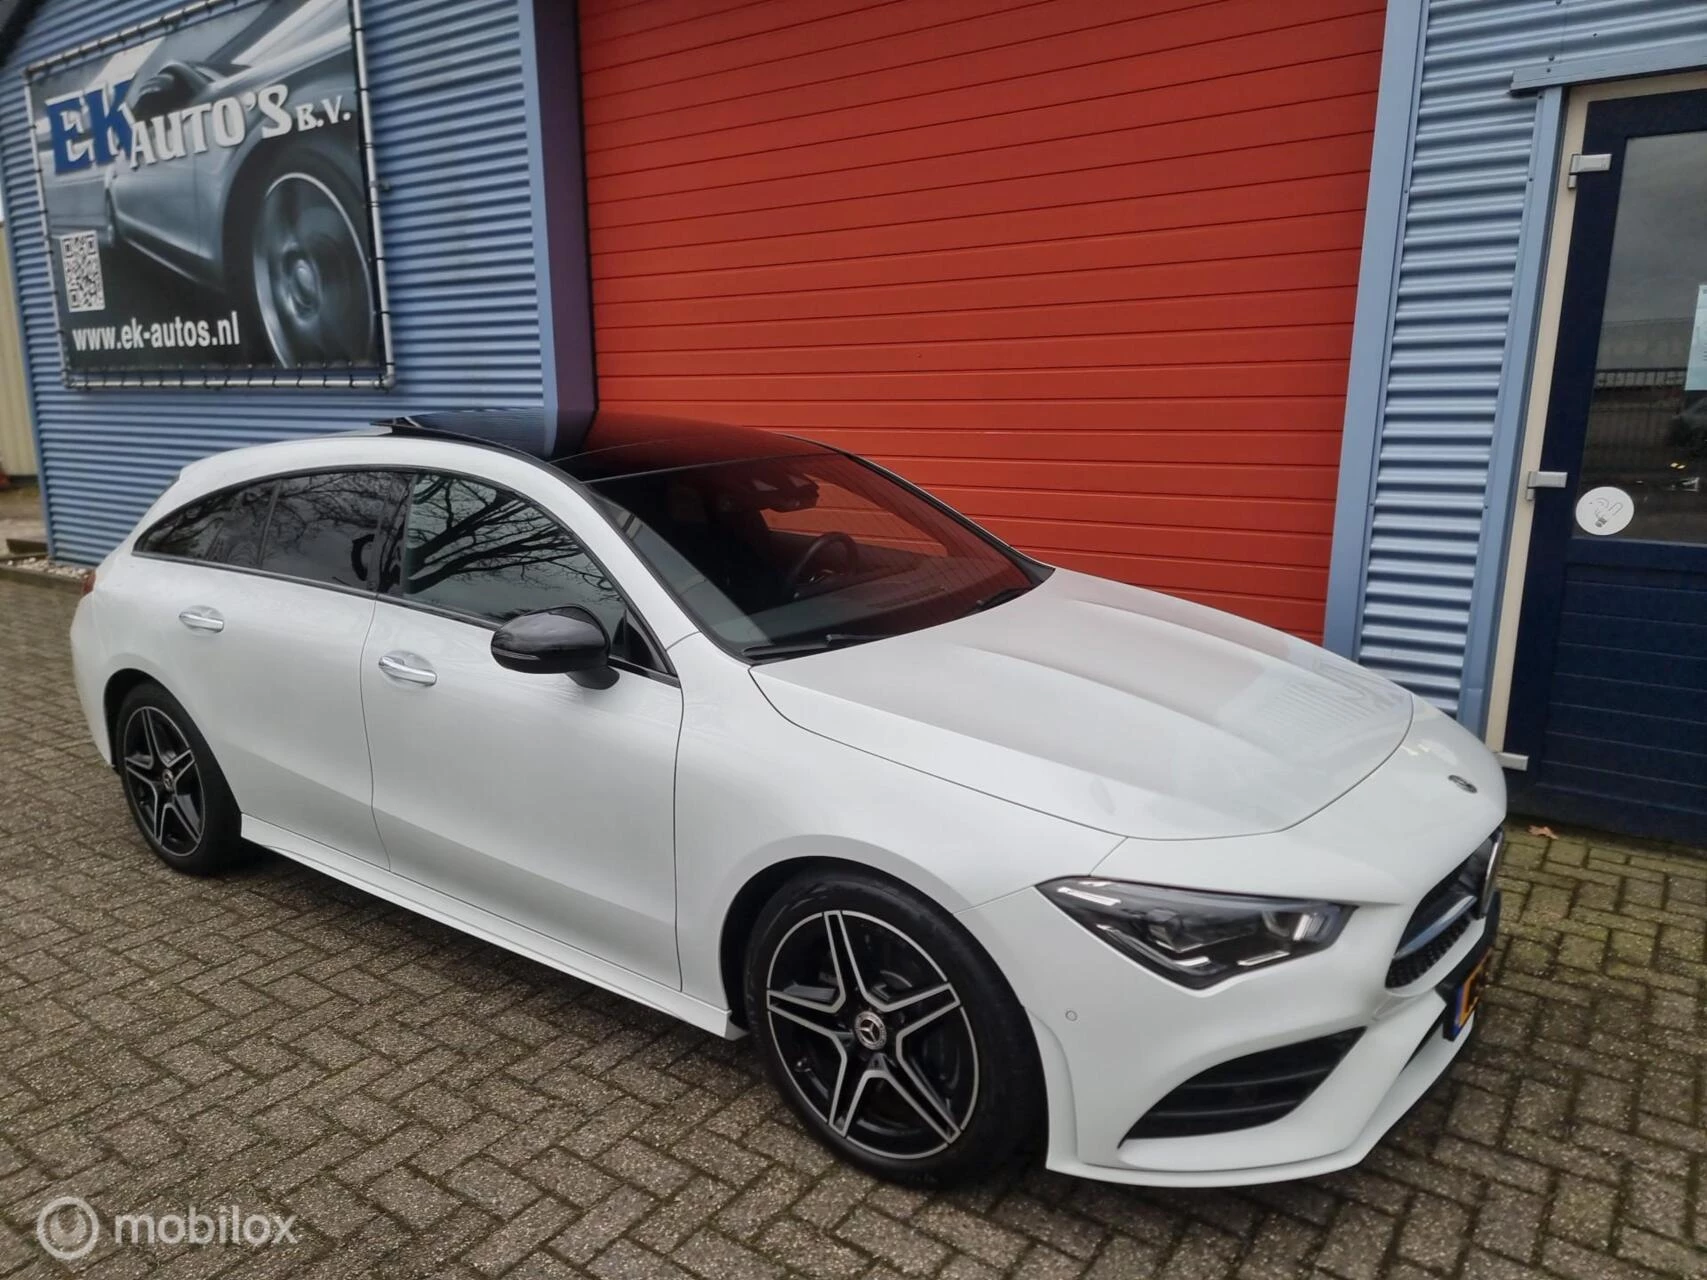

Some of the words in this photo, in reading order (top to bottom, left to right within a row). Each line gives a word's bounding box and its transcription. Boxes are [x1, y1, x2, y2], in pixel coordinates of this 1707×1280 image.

[46, 77, 136, 174] EK
[130, 84, 293, 170] AUTO'S
[295, 95, 352, 132] B.V.
[72, 311, 240, 351] www.ek-autos.nl
